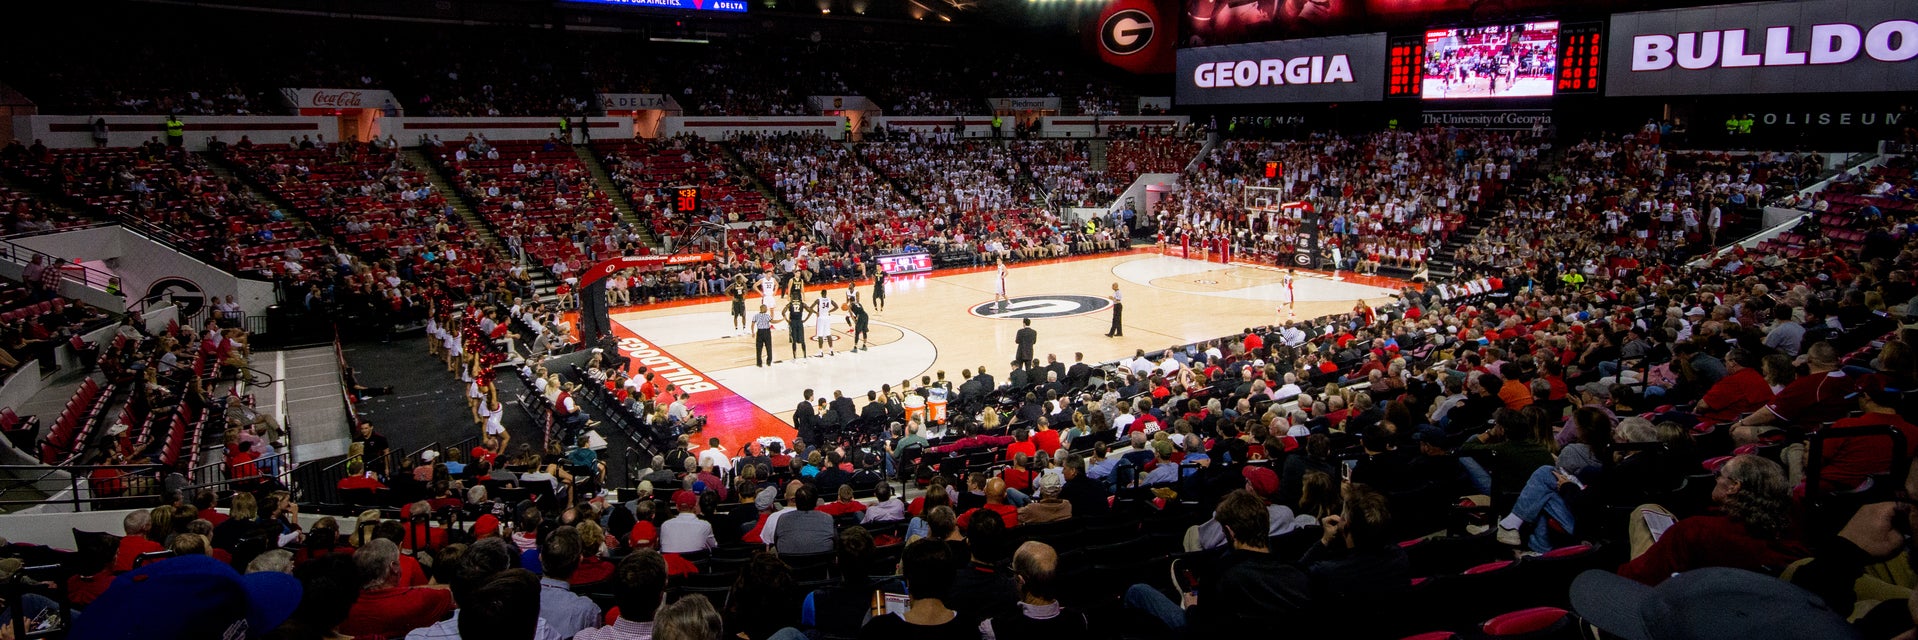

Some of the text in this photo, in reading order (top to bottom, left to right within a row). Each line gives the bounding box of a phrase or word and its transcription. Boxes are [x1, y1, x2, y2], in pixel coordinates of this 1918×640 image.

[721, 2, 743, 10] DELTA
[1631, 19, 1918, 72] BULLDO
[1194, 54, 1354, 88] GEORGIA
[313, 91, 361, 106] Coca-Cola
[620, 97, 664, 106] DELTA
[1012, 100, 1044, 108] Piedmont
[1421, 114, 1442, 124] The
[1443, 113, 1494, 126] University
[1493, 113, 1507, 124] of
[679, 189, 696, 197] 4:32
[678, 197, 695, 211] 30
[617, 337, 719, 394] BULLDOGS
